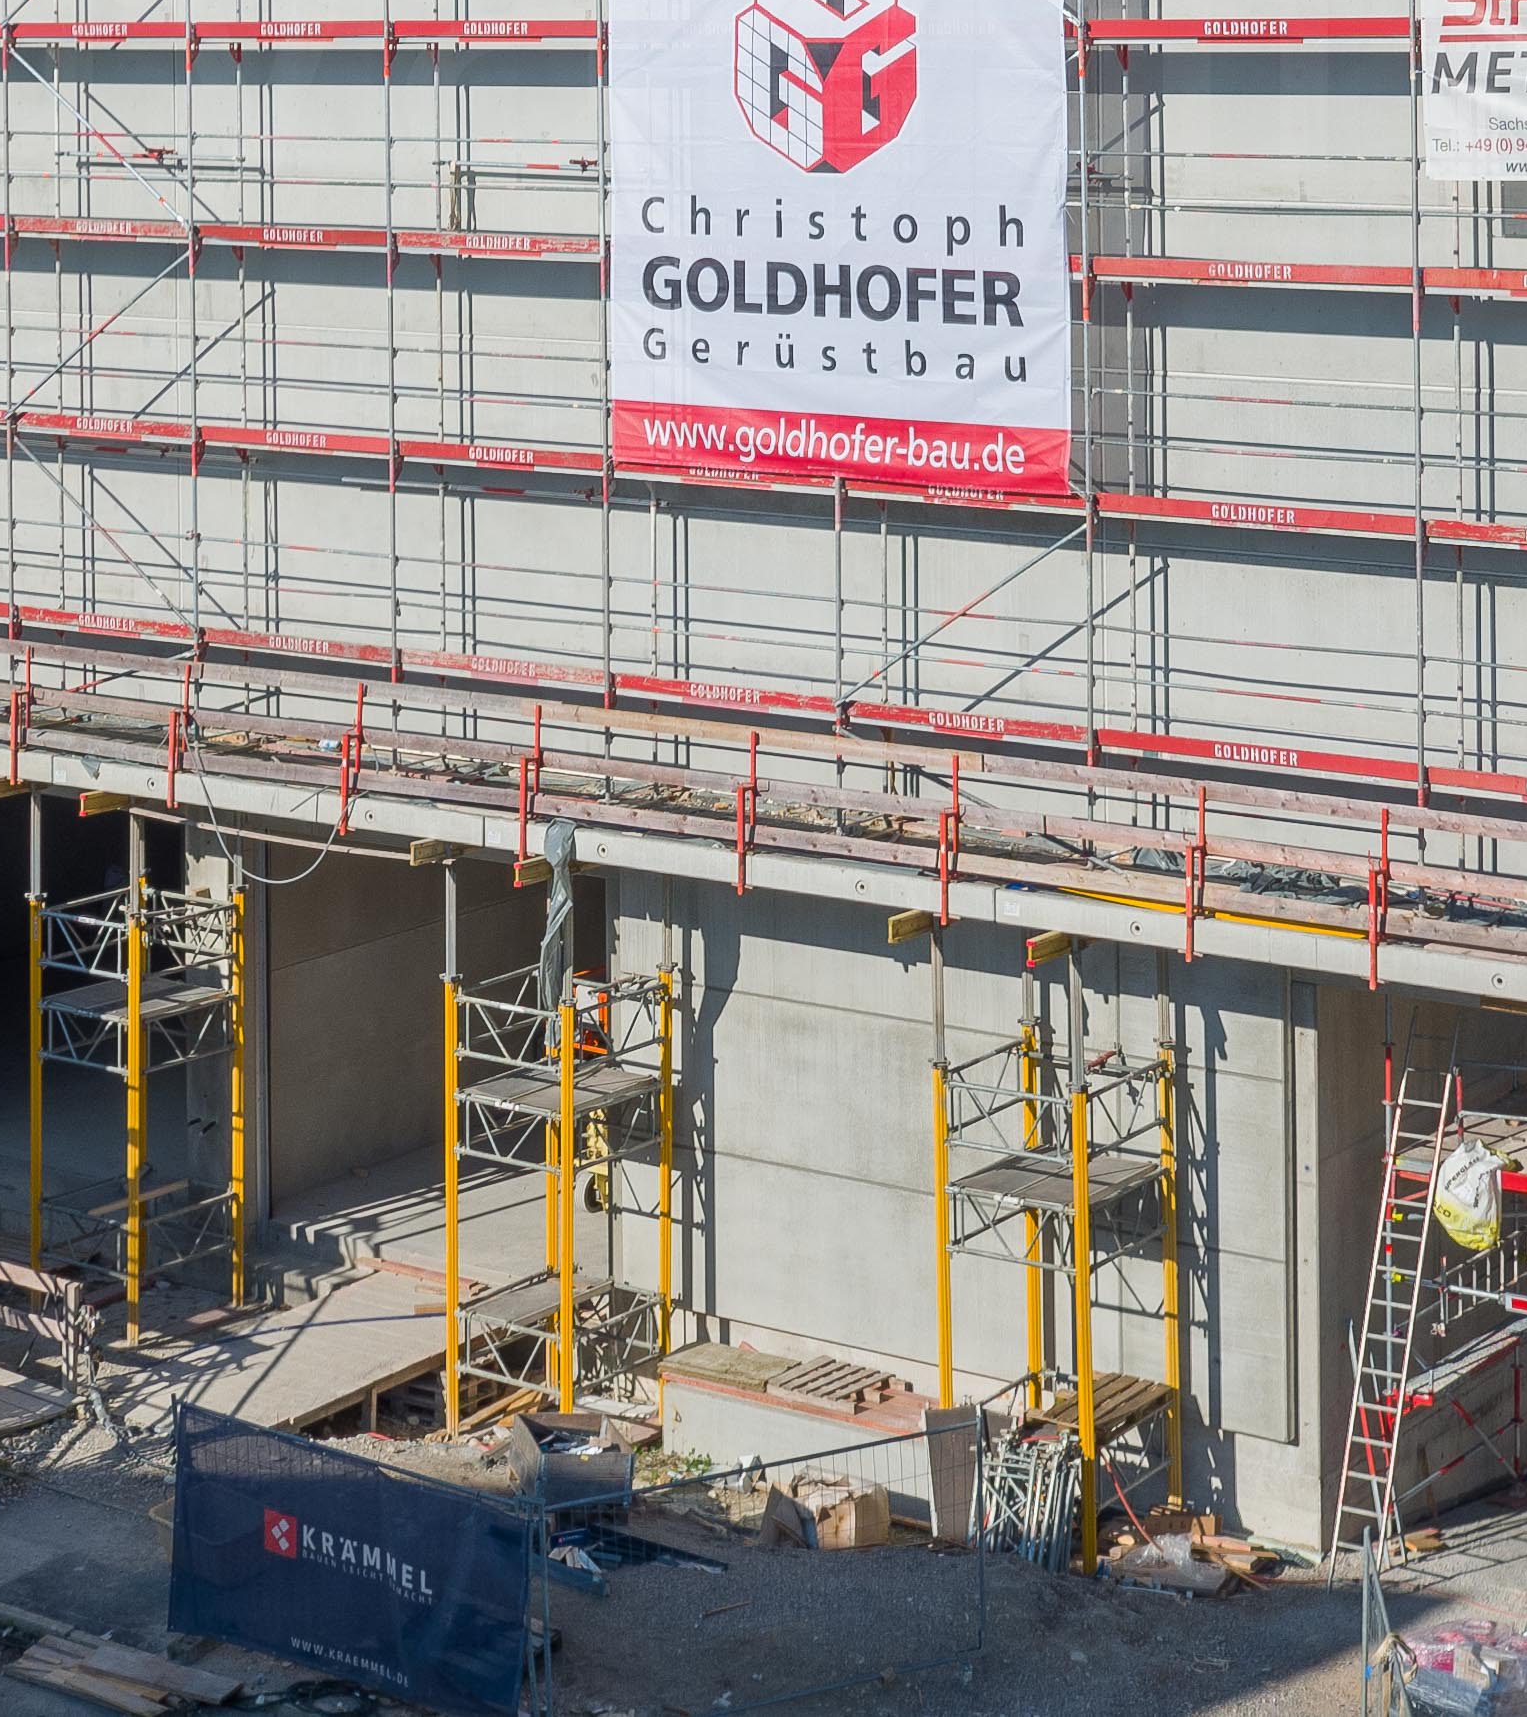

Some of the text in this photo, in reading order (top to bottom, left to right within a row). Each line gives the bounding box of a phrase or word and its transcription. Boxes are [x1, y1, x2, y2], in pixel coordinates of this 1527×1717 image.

[73, 25, 128, 38] GOLDHOFER
[261, 23, 322, 38] GOLDHOFER
[464, 23, 528, 36] GOLDHOFER
[1205, 21, 1288, 36] GOLDHOFER
[1432, 138, 1460, 152] Tel.:
[1464, 137, 1492, 152] +49
[1496, 137, 1513, 154] (0)
[641, 196, 1024, 255] Christoph
[264, 229, 324, 242] GOLDHOFER
[465, 235, 530, 249] GOLDHOFER
[1208, 265, 1292, 280] GOLDHOFER
[641, 256, 1024, 328] GOLDHOFER
[642, 327, 1028, 383] Gerüstbau
[76, 418, 132, 433] GOLDHOFER
[267, 432, 327, 448] GOLDHOFER
[643, 413, 1026, 475] www.goldhofer-bau.de
[469, 447, 534, 464] GOLDHOFER
[1213, 505, 1295, 524] GOLDHOFER
[78, 615, 135, 631] GOLDHOFER
[269, 635, 328, 653] GOLDHOFER
[689, 684, 760, 704] GOLDHOFER
[928, 710, 1004, 731] GOLDHOFER
[1214, 745, 1298, 764] GOLDHOFER
[303, 1525, 433, 1594] KRÄMMEL
